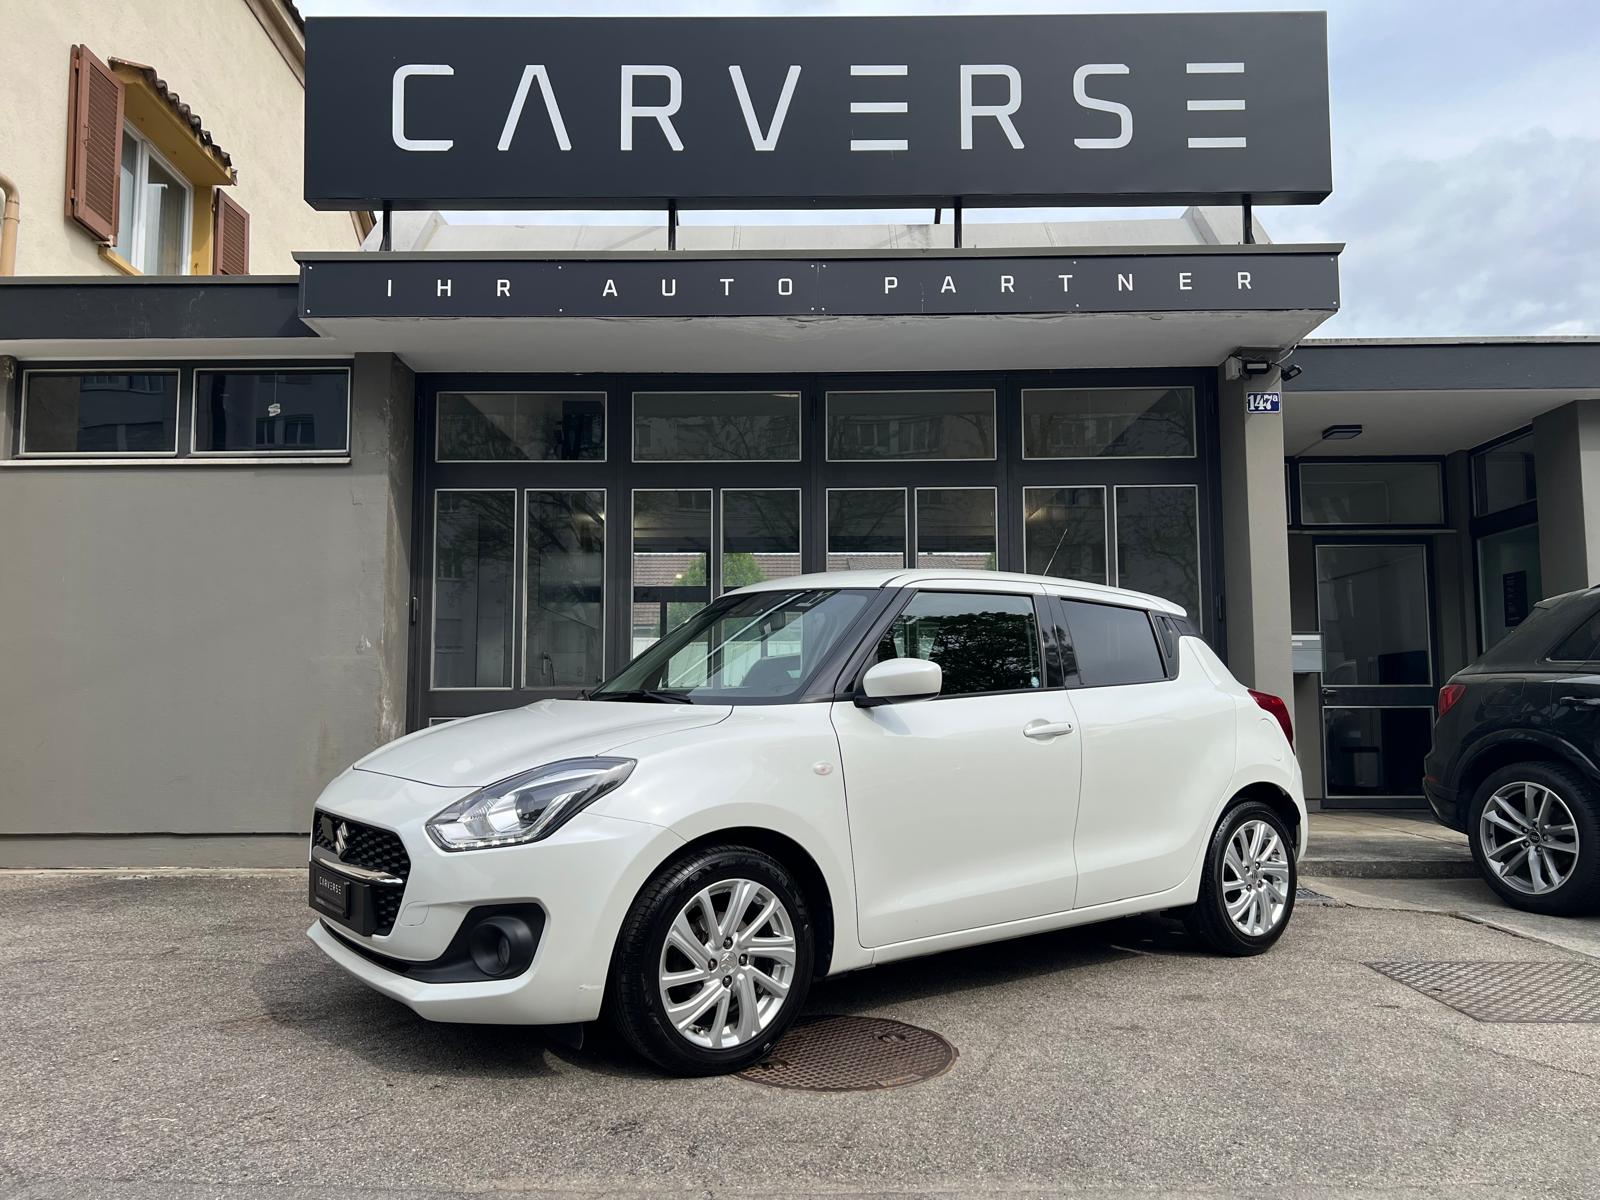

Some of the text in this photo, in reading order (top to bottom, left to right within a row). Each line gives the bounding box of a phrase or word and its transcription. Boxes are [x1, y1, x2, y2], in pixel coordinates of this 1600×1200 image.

[392, 62, 1247, 152] CARVERSE
[387, 271, 1252, 297] IHR AUTO PARTNER
[1248, 394, 1278, 410] 147a
[319, 876, 342, 895] CARVERSE
